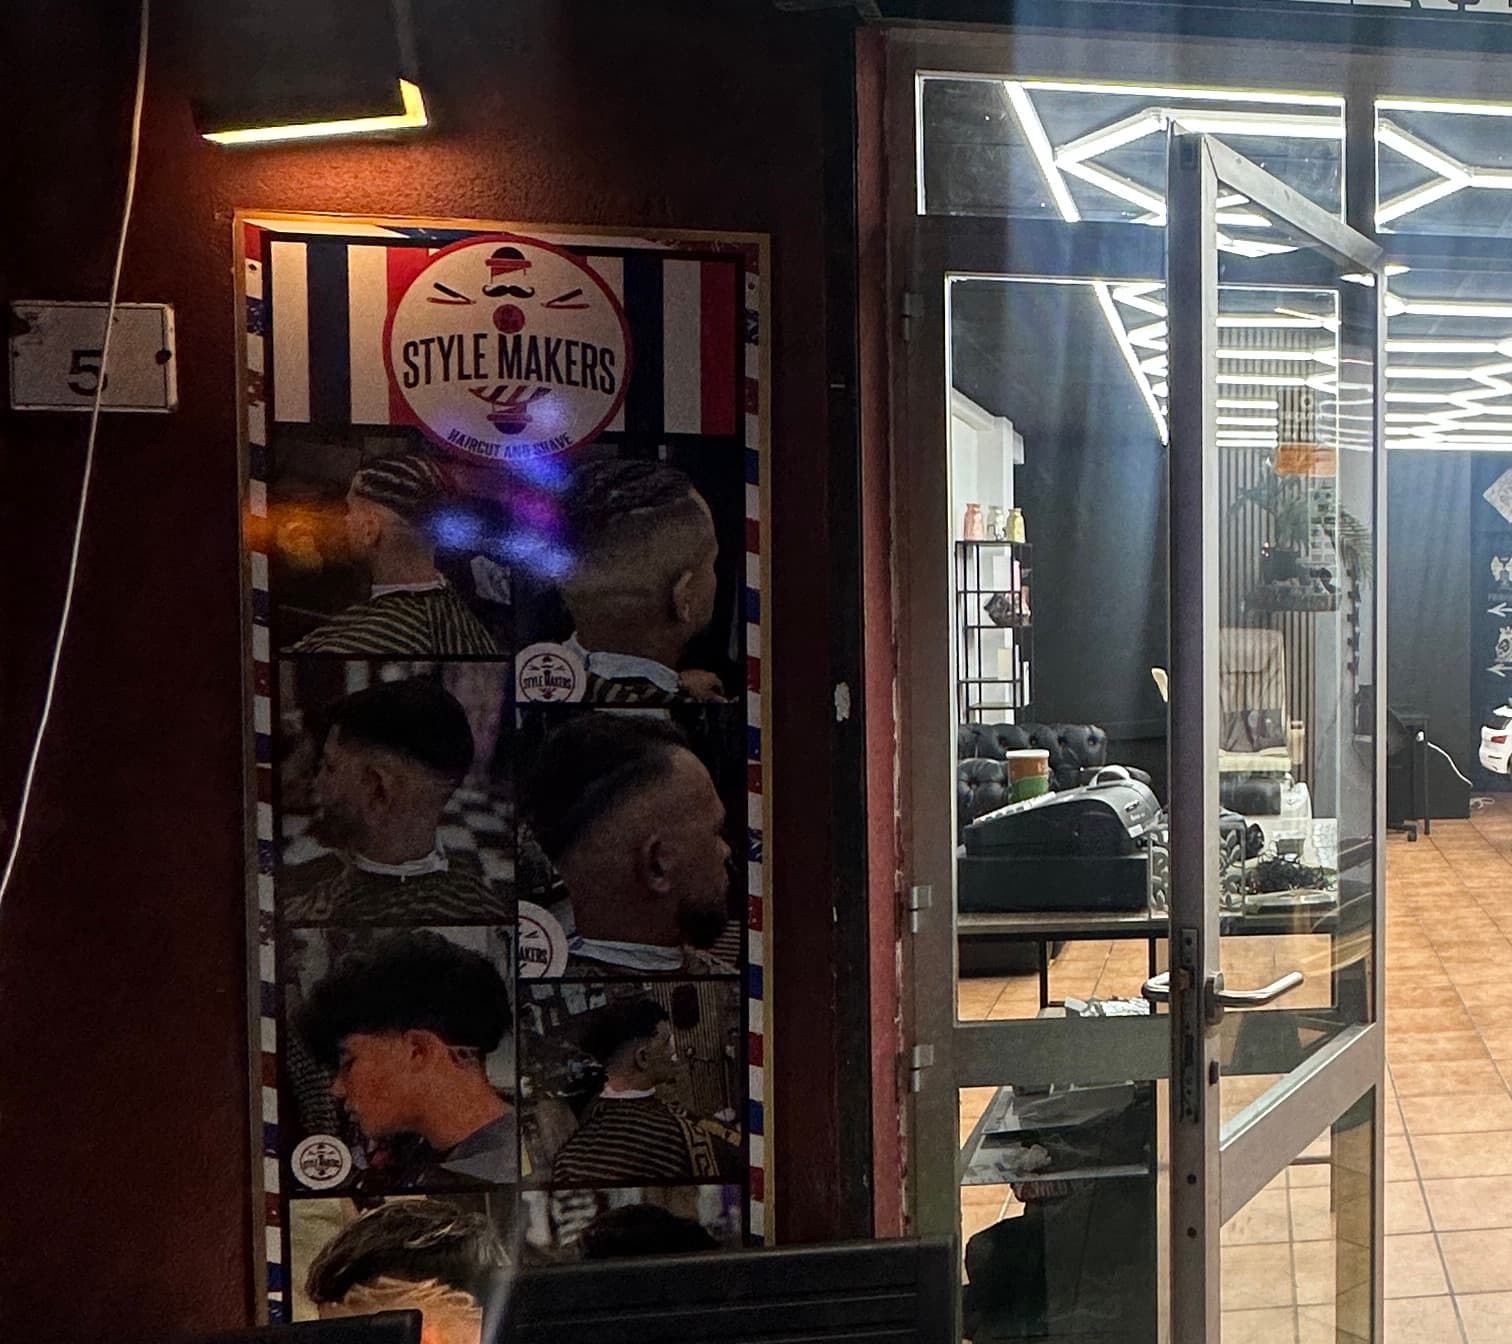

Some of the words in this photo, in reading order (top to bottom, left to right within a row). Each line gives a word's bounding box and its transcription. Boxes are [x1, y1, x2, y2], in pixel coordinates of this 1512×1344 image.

[67, 349, 109, 396] 5
[402, 332, 489, 389] STYLE
[497, 333, 617, 396] MAKERS
[447, 427, 501, 456] HAIRCUT
[503, 444, 531, 458] AND
[532, 431, 574, 455] SHAVE
